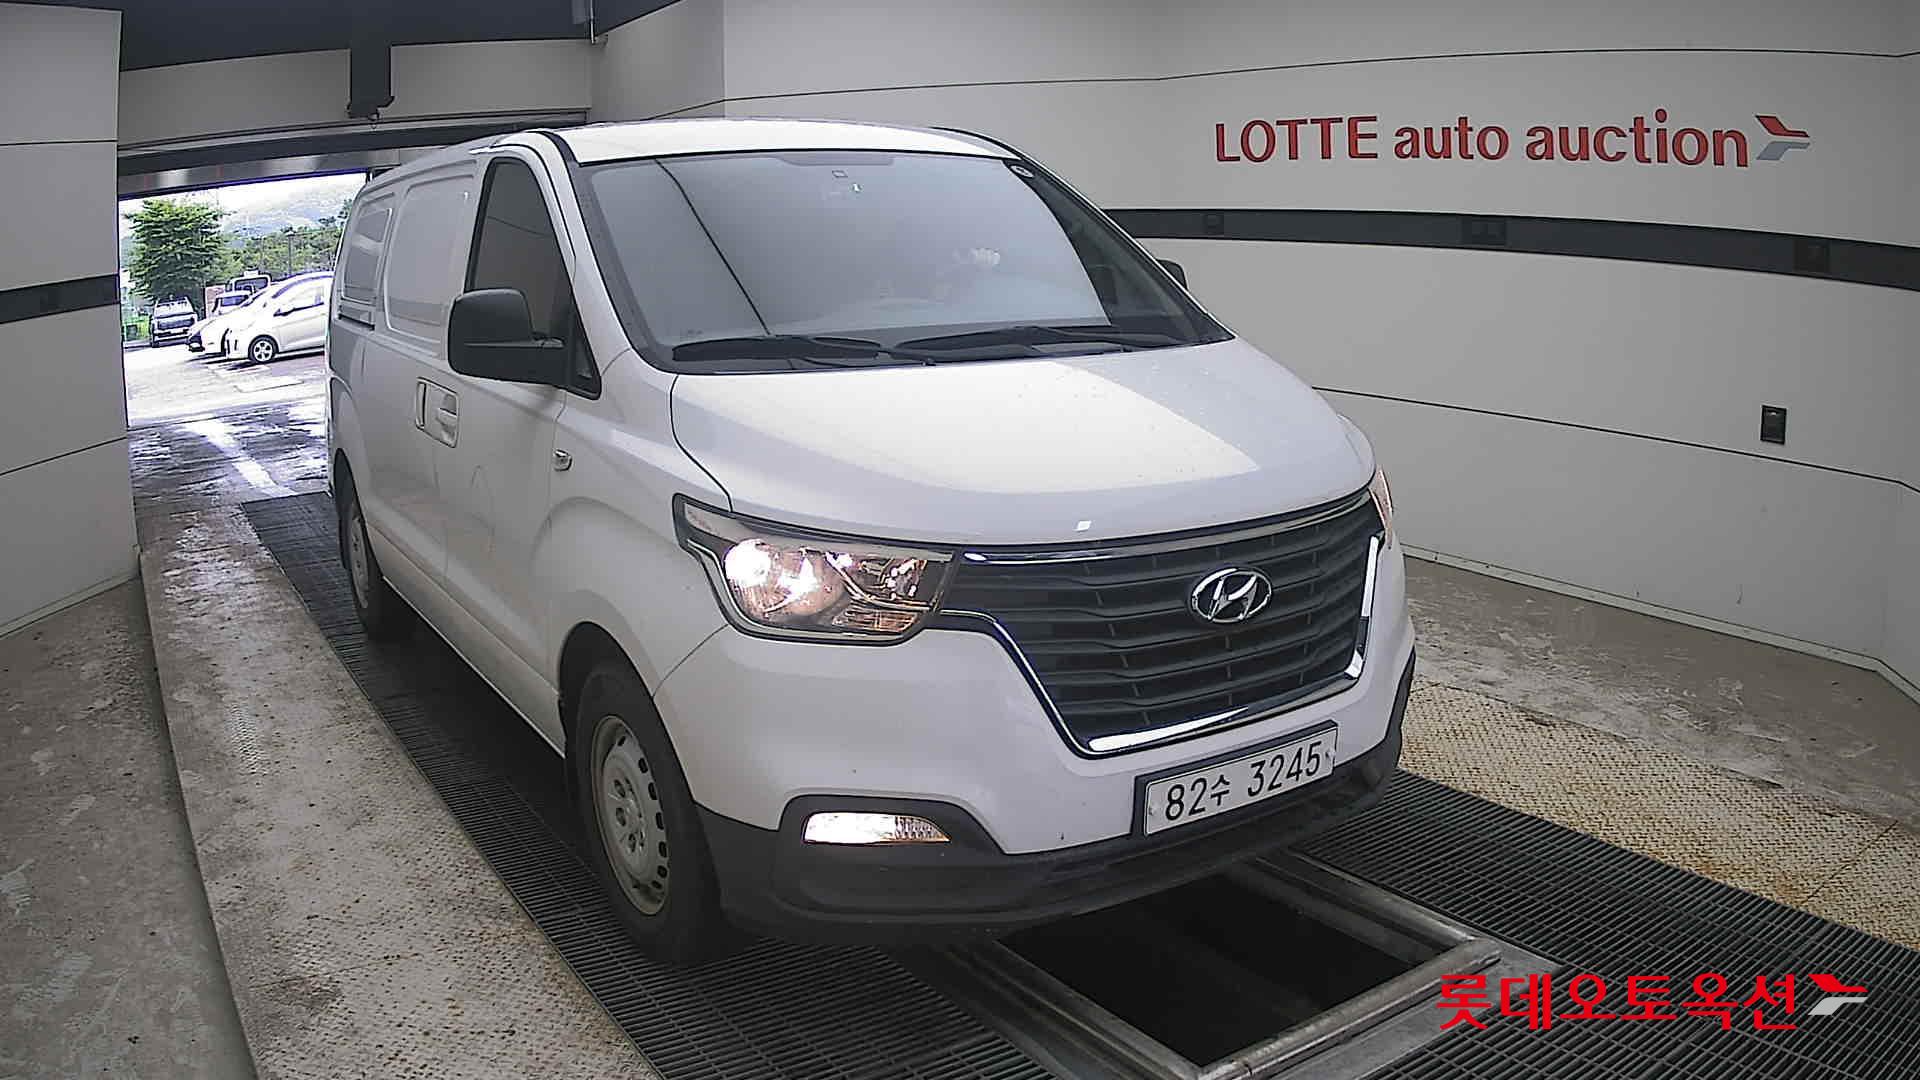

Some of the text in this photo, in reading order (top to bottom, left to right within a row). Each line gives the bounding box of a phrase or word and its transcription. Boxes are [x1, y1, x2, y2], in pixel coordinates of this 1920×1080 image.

[1215, 108, 1749, 168] LOTTE auto auction
[1164, 740, 1323, 821] 82수 3245
